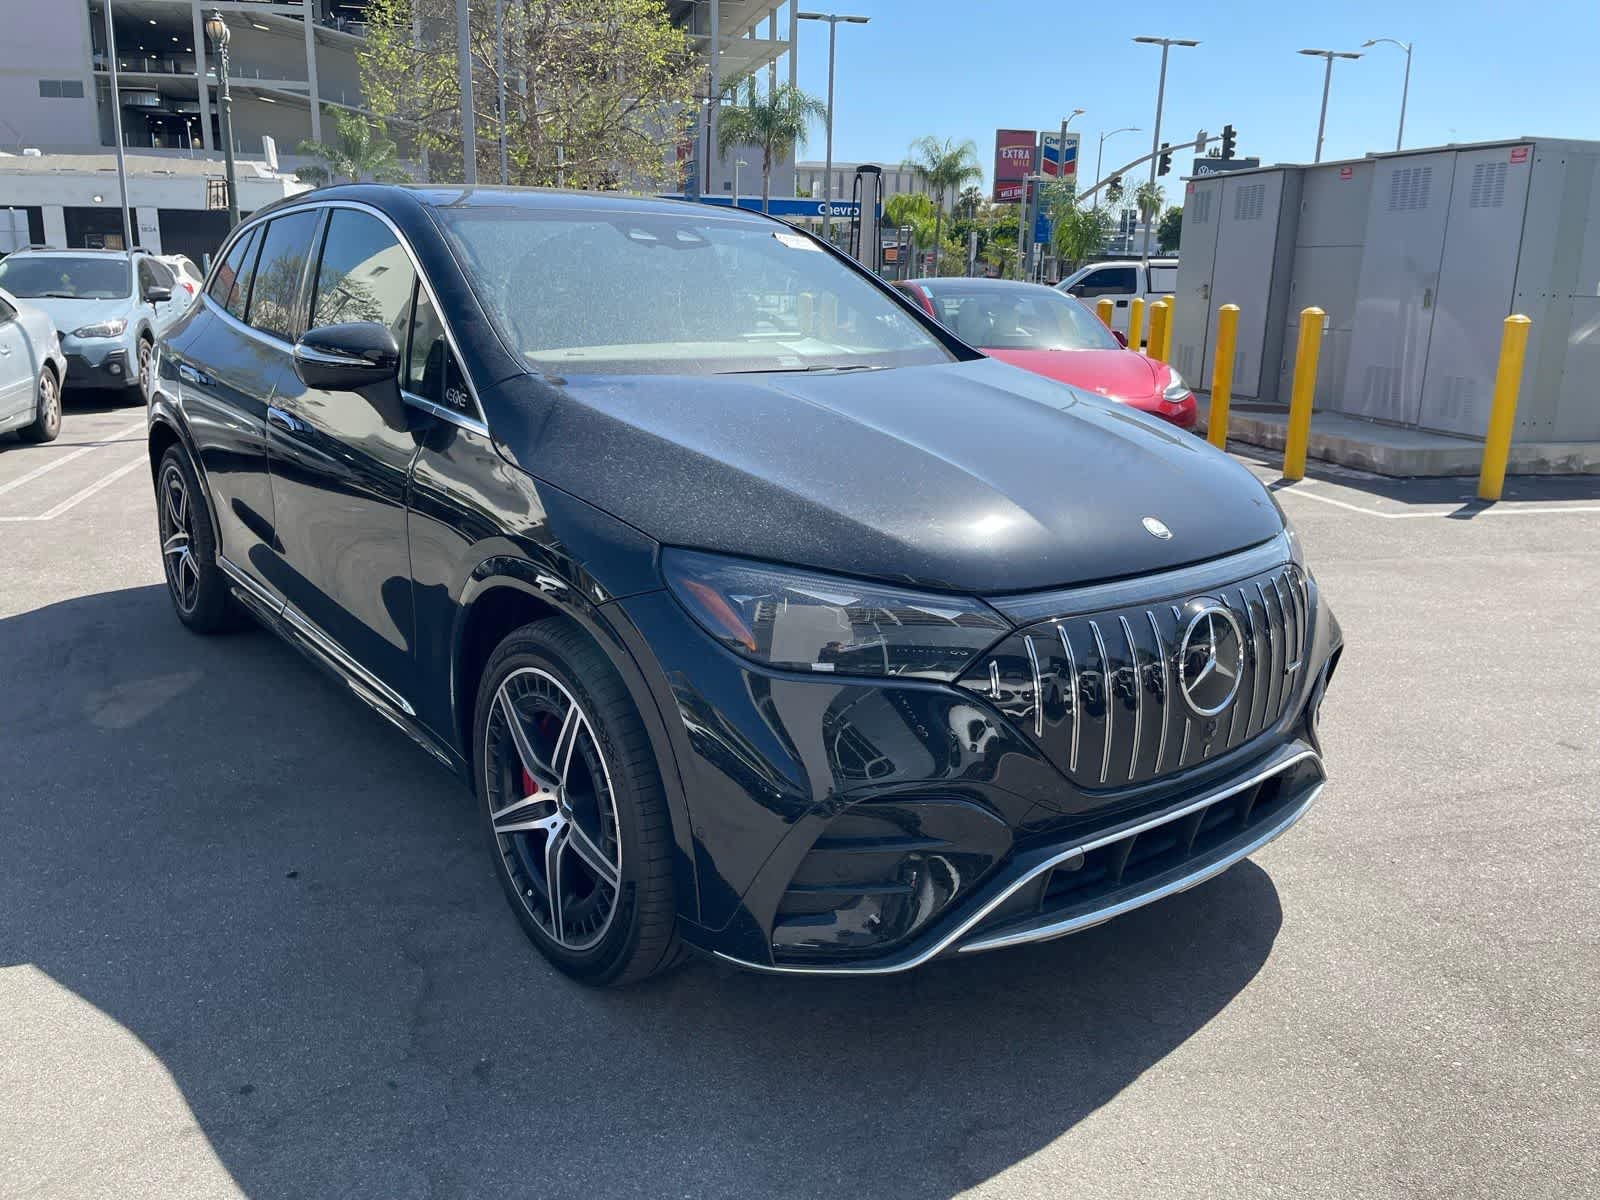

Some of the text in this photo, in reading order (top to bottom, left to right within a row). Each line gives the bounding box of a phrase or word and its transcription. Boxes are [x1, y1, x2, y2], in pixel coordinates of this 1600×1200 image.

[1044, 136, 1078, 145] Cheon
[1002, 149, 1030, 159] EXTRA
[817, 203, 860, 216] Cevro
[446, 388, 467, 407] EQE
